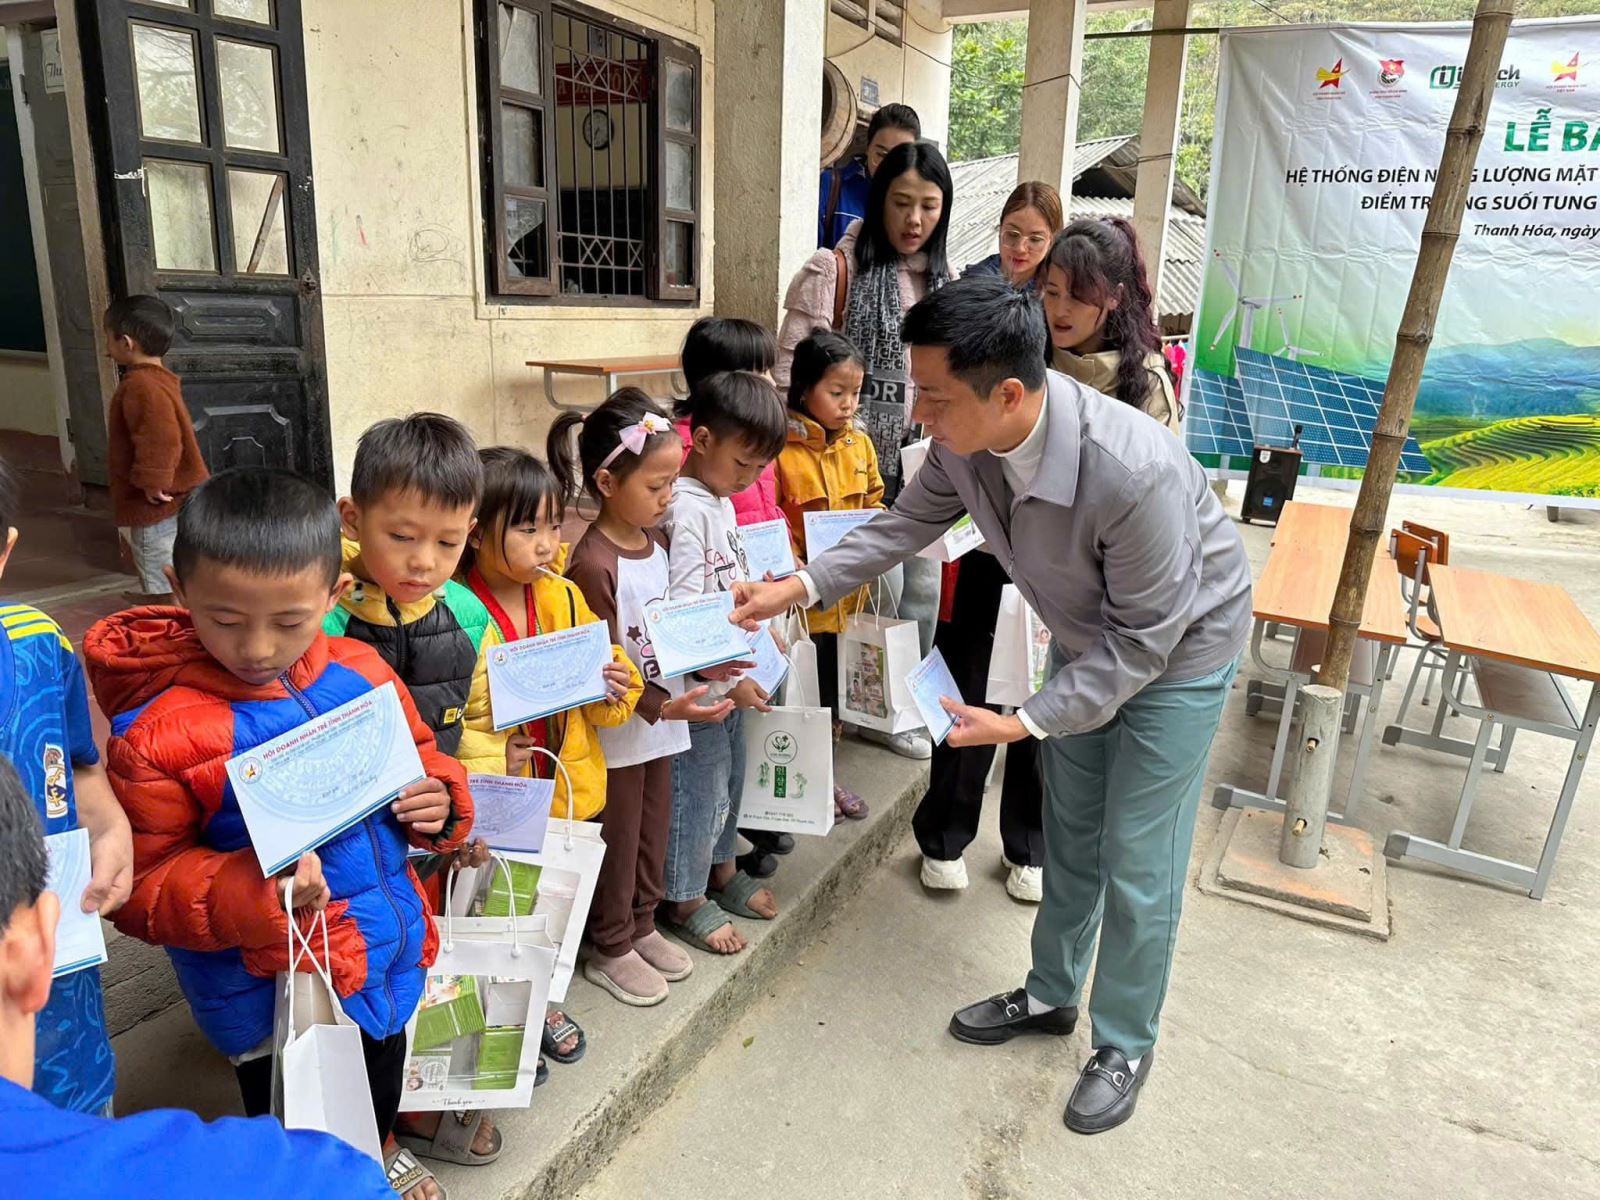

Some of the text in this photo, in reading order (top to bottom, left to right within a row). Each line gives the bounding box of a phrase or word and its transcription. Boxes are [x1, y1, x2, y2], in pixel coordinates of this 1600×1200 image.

[1504, 108, 1552, 151] LỄ
[1286, 167, 1308, 187] HỆ
[1311, 165, 1373, 183] THỐNG
[1377, 166, 1420, 187] ĐIỆN
[1483, 166, 1551, 186] LƯỢNG
[1556, 164, 1598, 186] MẶT
[1361, 191, 1406, 210] ĐIỂM
[1492, 191, 1538, 211] SUỐI
[1543, 195, 1598, 211] TUNG
[1474, 223, 1600, 240] Thanh Hóa, ngày
